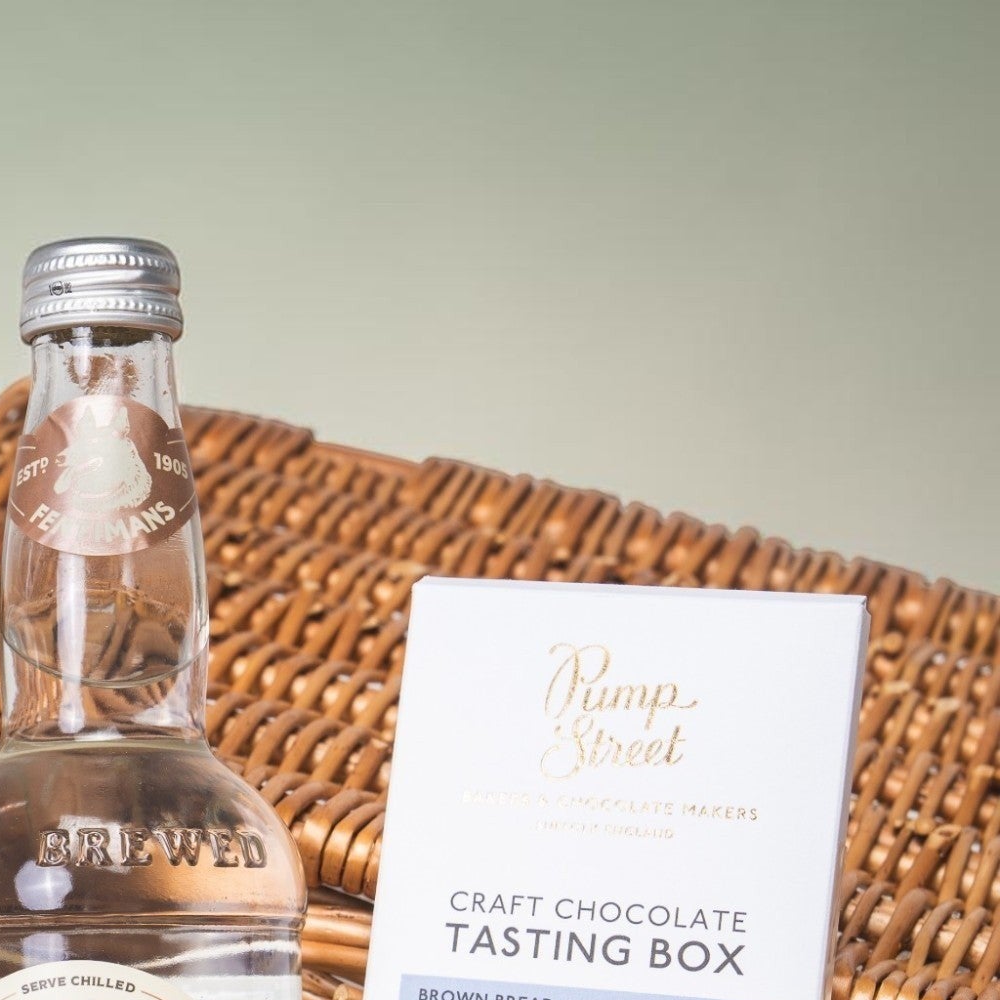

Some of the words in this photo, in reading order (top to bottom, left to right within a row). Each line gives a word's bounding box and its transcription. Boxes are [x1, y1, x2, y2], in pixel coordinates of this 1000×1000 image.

[153, 452, 188, 479] 1905
[544, 643, 698, 731] Pump
[540, 716, 689, 781] Street
[682, 803, 758, 821] MAKERS
[37, 827, 267, 868] BREWED
[450, 891, 543, 917] CRAFT
[555, 897, 747, 934] CHOCOLATE
[445, 921, 631, 967] TASTING
[650, 938, 746, 976] BOX
[21, 976, 67, 995] SERVE
[71, 975, 136, 993] CHILLED
